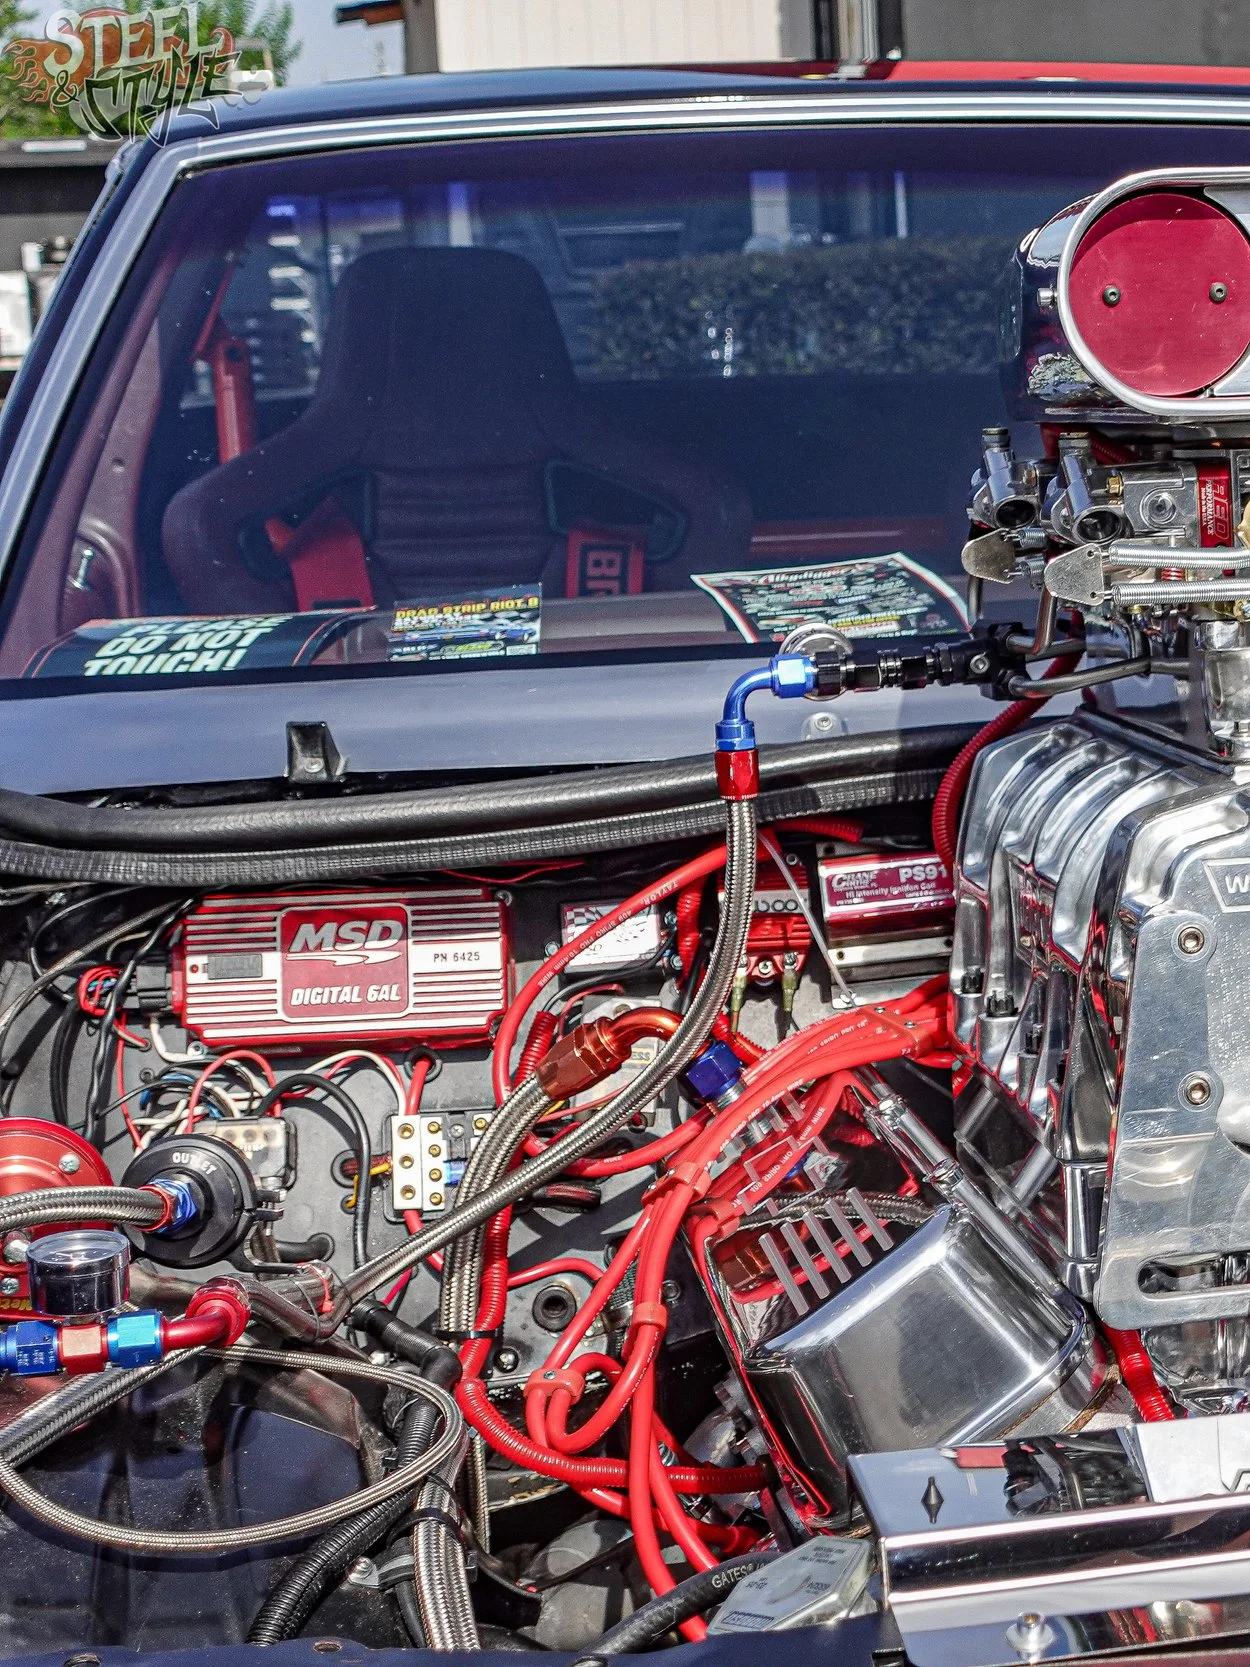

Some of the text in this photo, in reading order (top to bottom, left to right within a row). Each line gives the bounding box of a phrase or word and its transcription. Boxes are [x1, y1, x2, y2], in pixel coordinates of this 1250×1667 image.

[1205, 479, 1214, 535] PERFORMANCE
[490, 598, 524, 611] RIOT
[120, 616, 293, 637] PLEASE
[95, 627, 274, 658] DO NOT
[84, 649, 248, 676] TOUCH!
[899, 864, 948, 883] PS91
[855, 888, 889, 899] Intensity
[289, 920, 404, 953] MSD
[594, 919, 617, 938] SPIRO
[578, 936, 595, 950] PRO
[433, 951, 481, 963] PN 6425
[290, 983, 402, 1007] DIGITAL 6AL
[172, 1152, 218, 1175] OUET
